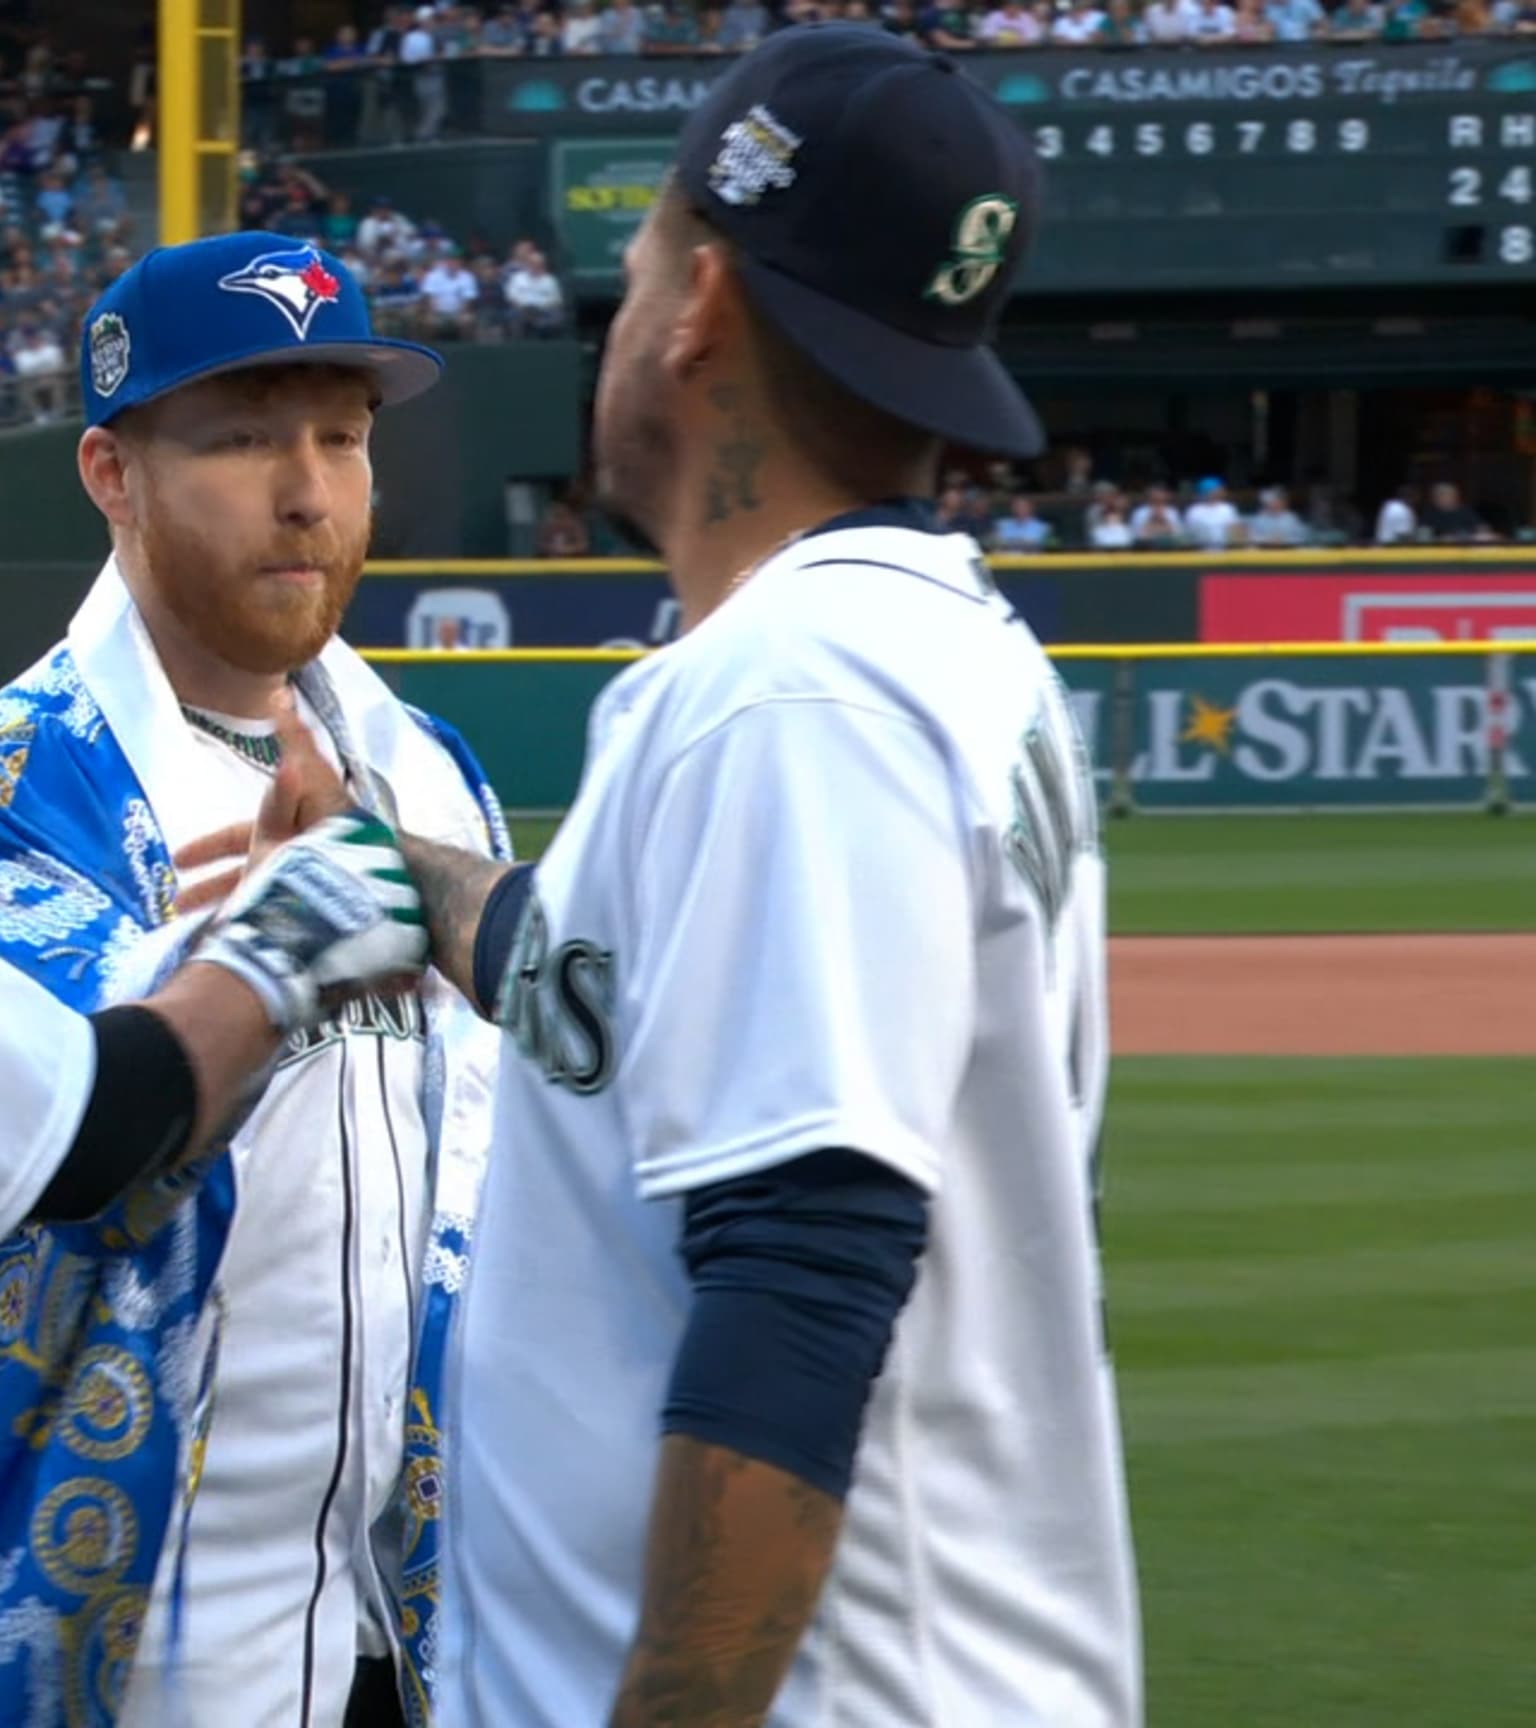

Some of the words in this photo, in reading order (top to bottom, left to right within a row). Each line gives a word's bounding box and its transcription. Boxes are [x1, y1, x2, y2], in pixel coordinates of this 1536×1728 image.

[1061, 65, 1323, 102] CASAMIGOS
[1036, 126, 1063, 159] 3
[1086, 126, 1114, 157] 4
[1135, 123, 1164, 155] 5
[1185, 122, 1214, 155] 6
[1237, 121, 1265, 153] 7
[1287, 119, 1316, 152] 8
[1338, 119, 1369, 152] 9
[1449, 115, 1483, 147] R
[1501, 114, 1535, 147] H
[1449, 167, 1482, 206] 2
[1498, 166, 1534, 204] 4
[1500, 225, 1534, 264] 8
